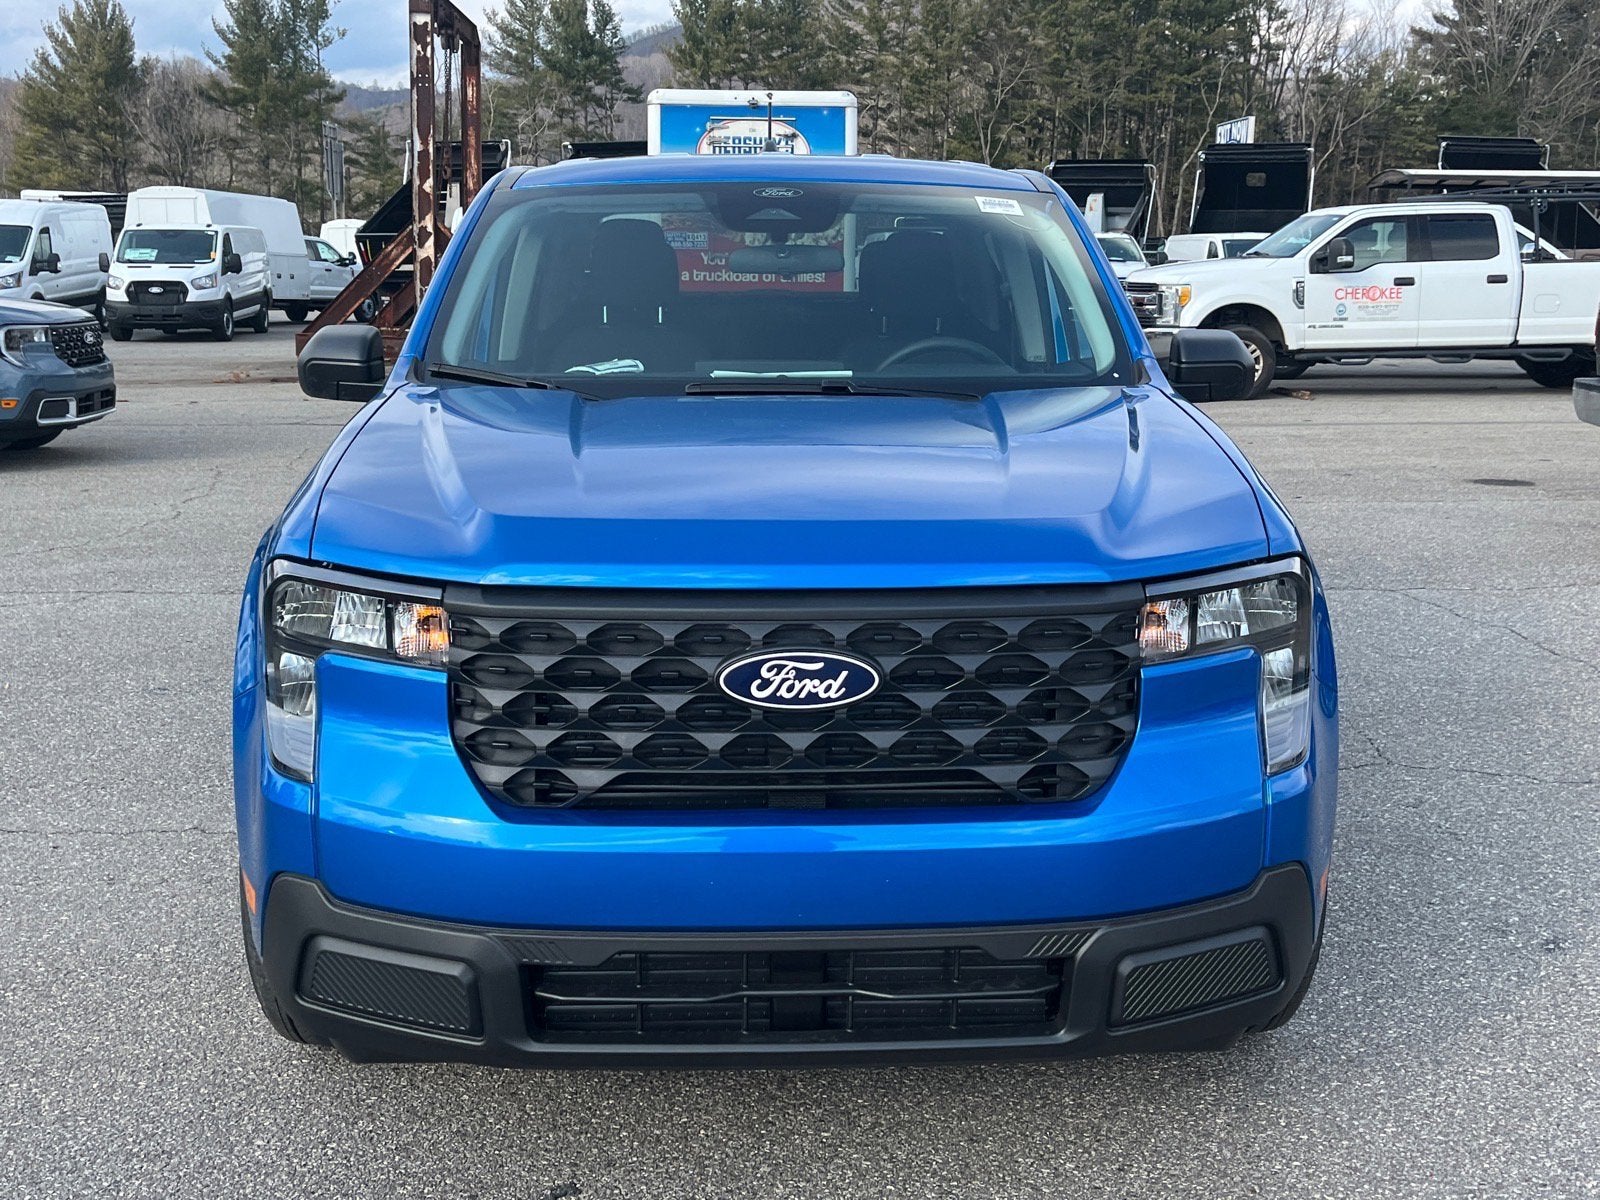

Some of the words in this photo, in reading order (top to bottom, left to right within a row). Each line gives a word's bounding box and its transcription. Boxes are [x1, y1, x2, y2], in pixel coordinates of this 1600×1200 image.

[762, 187, 794, 196] Ford
[681, 271, 689, 281] a
[693, 269, 759, 281] truckload
[1335, 286, 1403, 301] CHEROKEE
[751, 660, 848, 699] Ford
